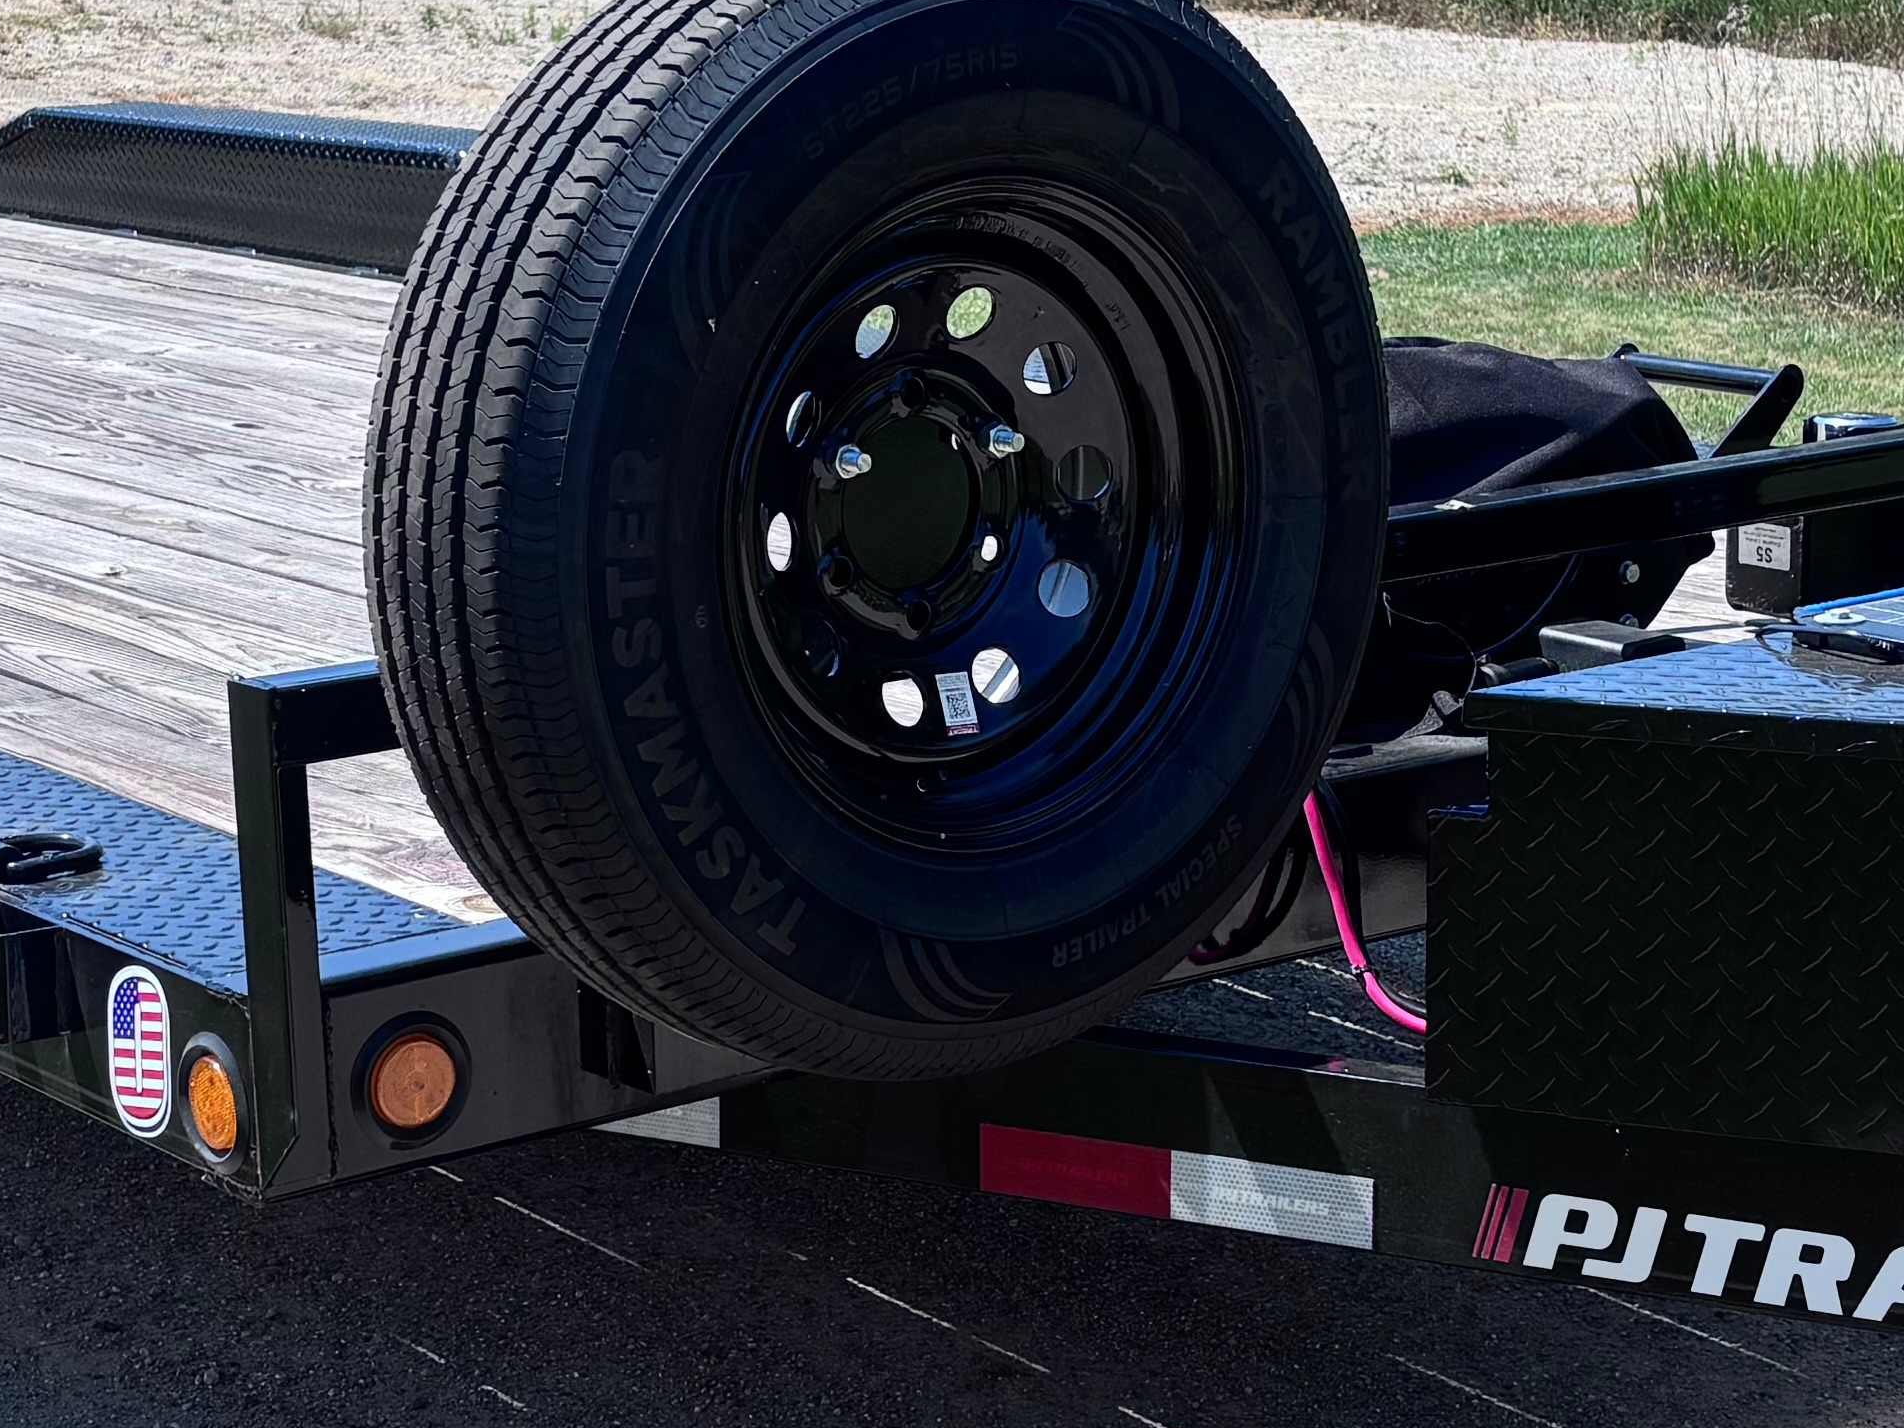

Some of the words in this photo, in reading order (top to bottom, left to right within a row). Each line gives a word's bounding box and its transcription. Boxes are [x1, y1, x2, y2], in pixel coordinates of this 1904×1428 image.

[802, 43, 1020, 161] ST225/75R15
[1259, 157, 1375, 503] RAMBLER
[604, 449, 807, 958] TASKMASTER
[1154, 812, 1246, 906] SPECIAL
[1051, 901, 1153, 969] TRAILER
